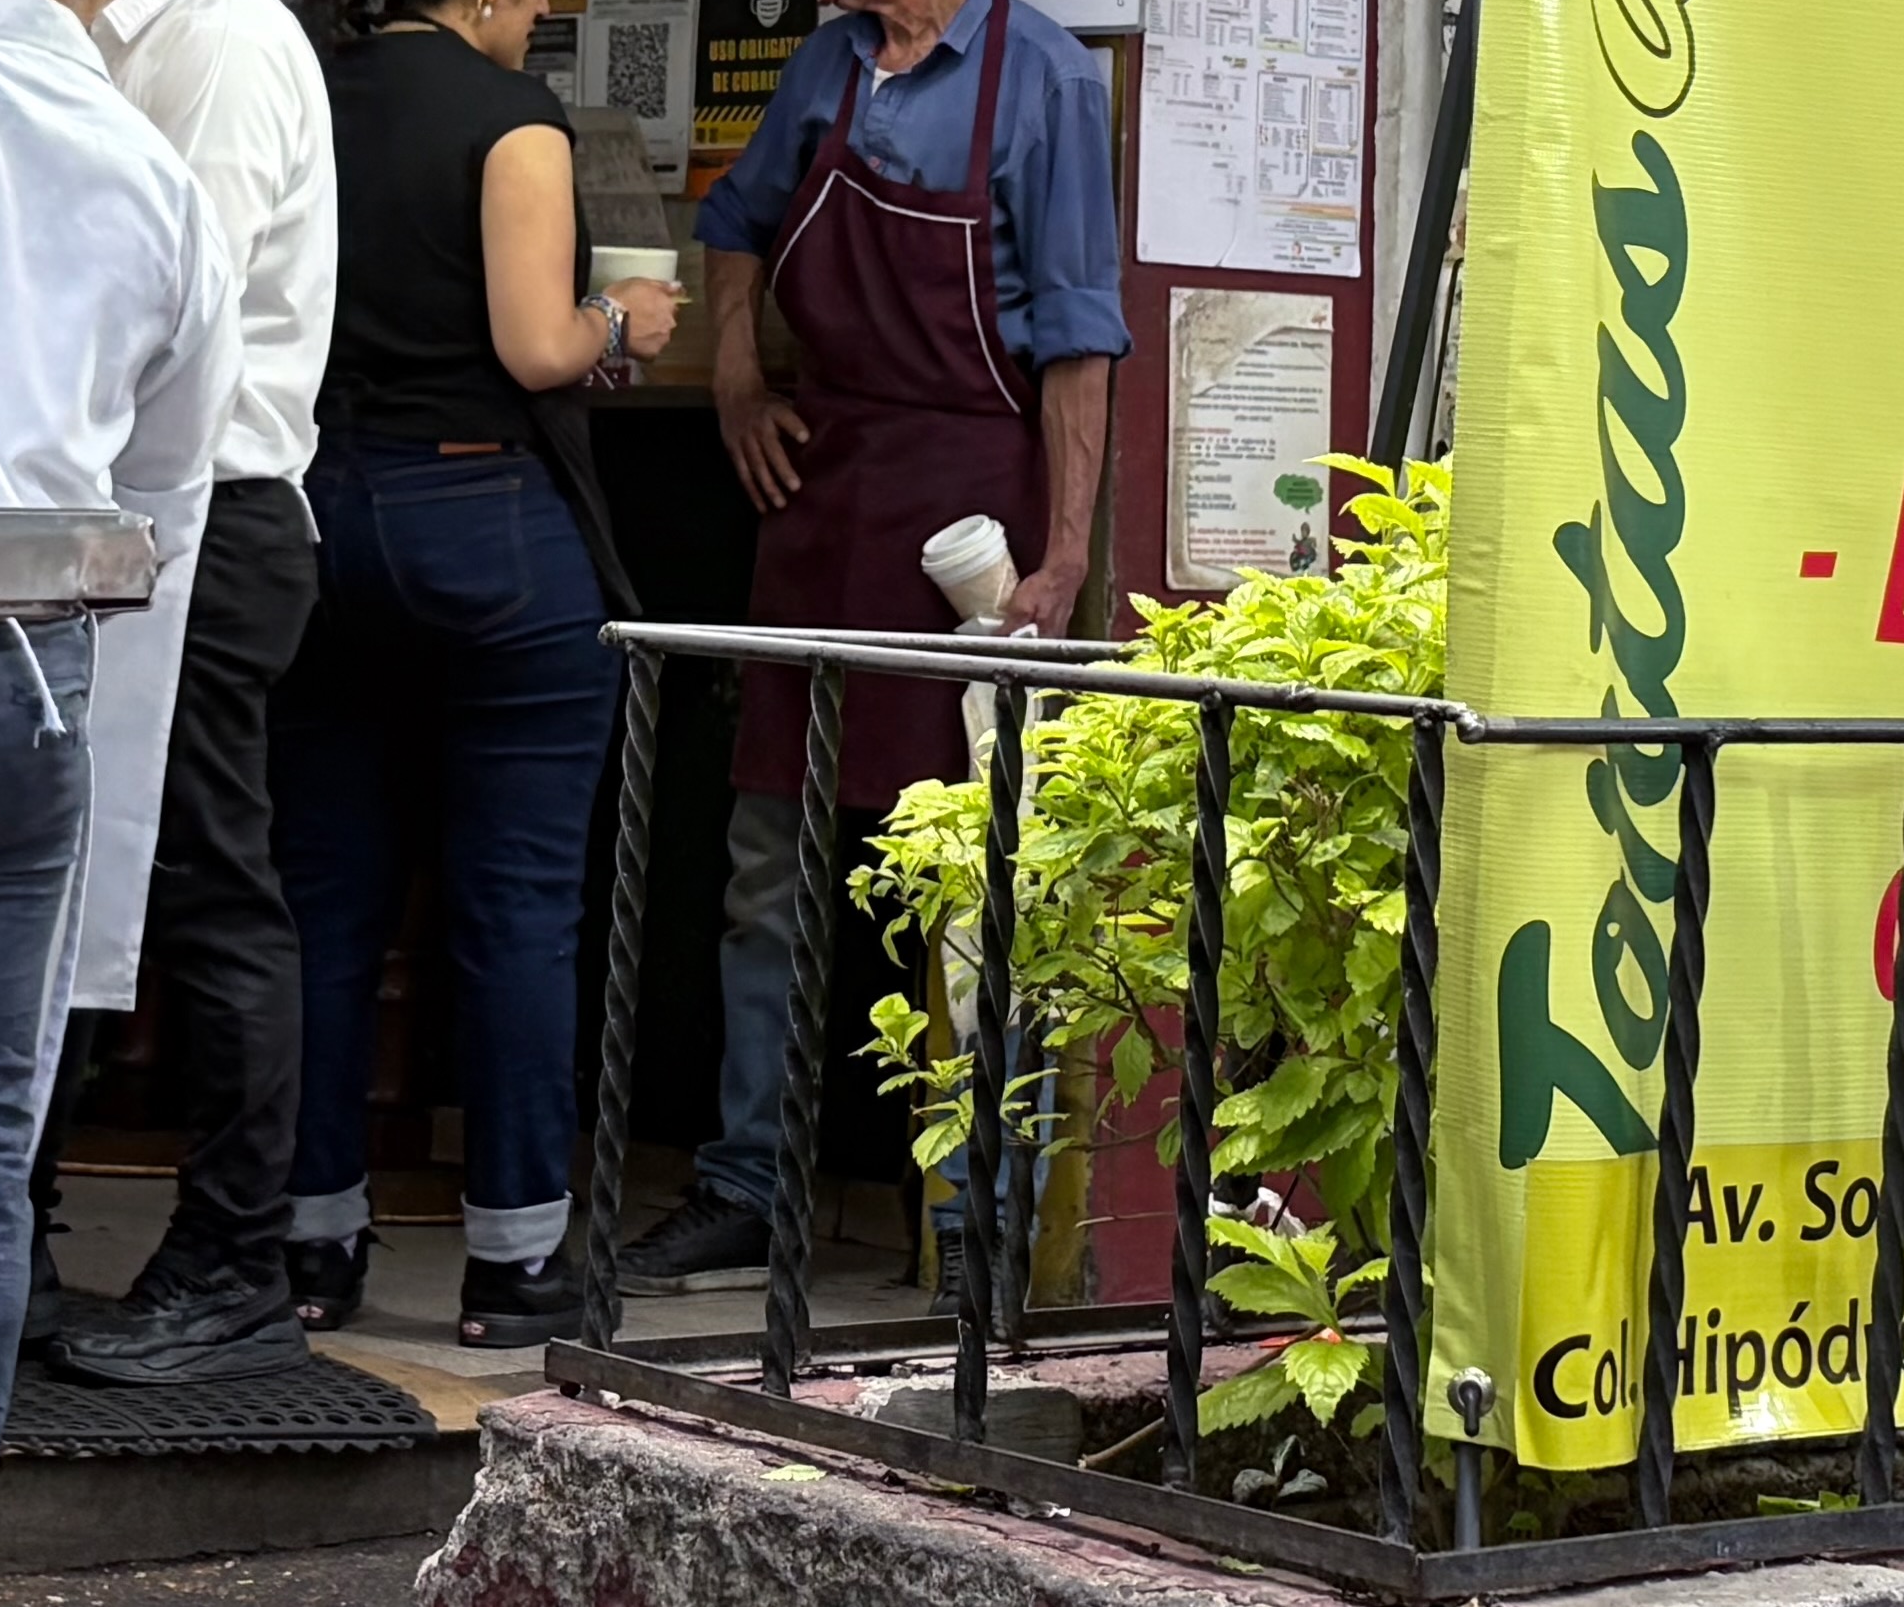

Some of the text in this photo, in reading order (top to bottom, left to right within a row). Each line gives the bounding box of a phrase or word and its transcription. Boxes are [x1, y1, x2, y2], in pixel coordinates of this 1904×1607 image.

[708, 35, 805, 62] USO OBLIGATO
[712, 69, 781, 94] DE CUBRE
[1496, 129, 1689, 1172] Tortas
[1680, 1165, 1776, 1245] Av.
[1532, 1331, 1639, 1419] Col.
